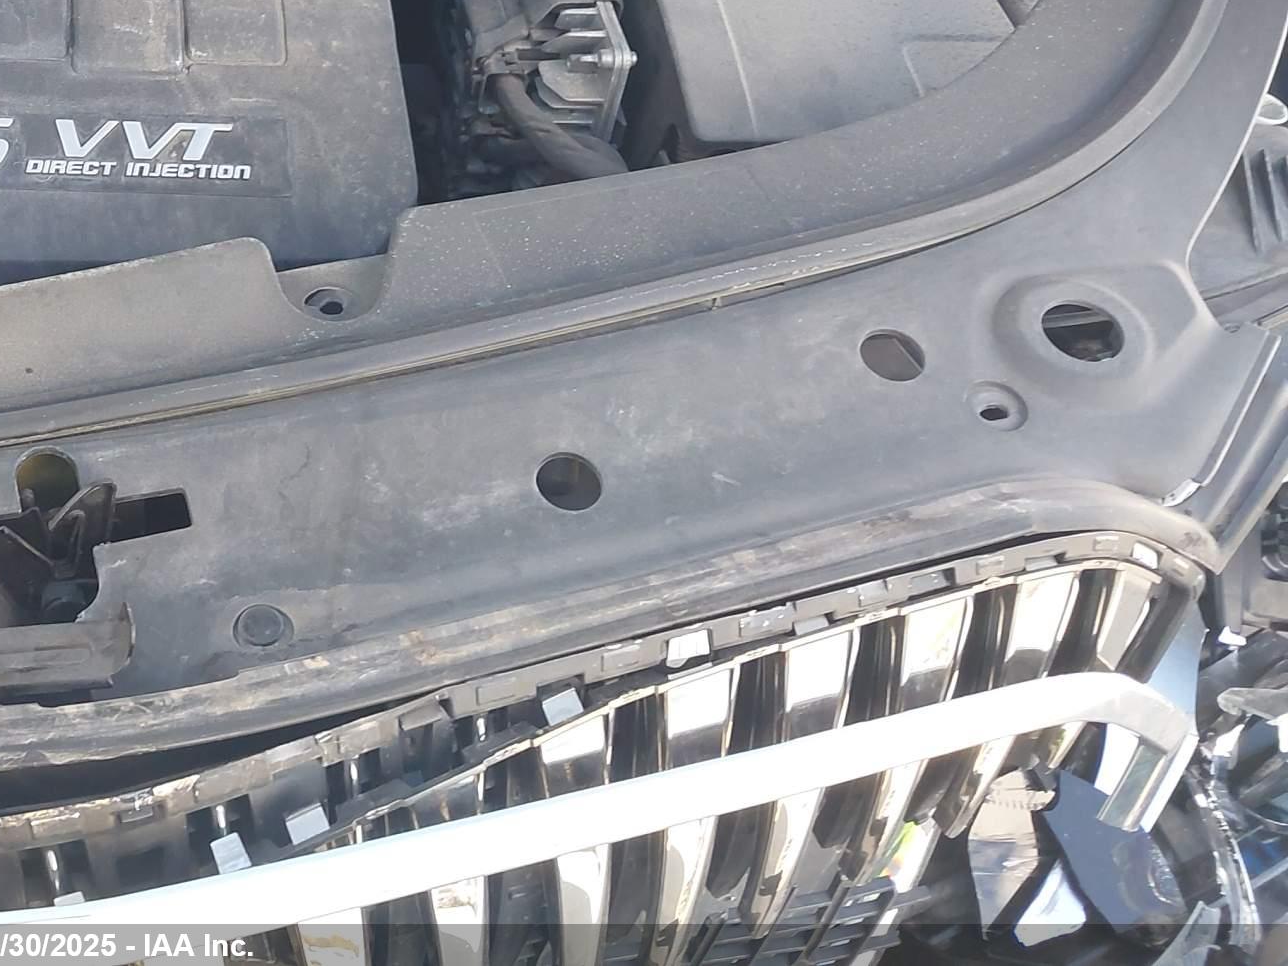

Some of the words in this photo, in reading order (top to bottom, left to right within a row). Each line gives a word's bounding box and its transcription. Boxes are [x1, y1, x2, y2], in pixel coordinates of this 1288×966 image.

[55, 118, 234, 161] VVT
[25, 160, 117, 177] DIRECT
[125, 162, 252, 180] INJECTION
